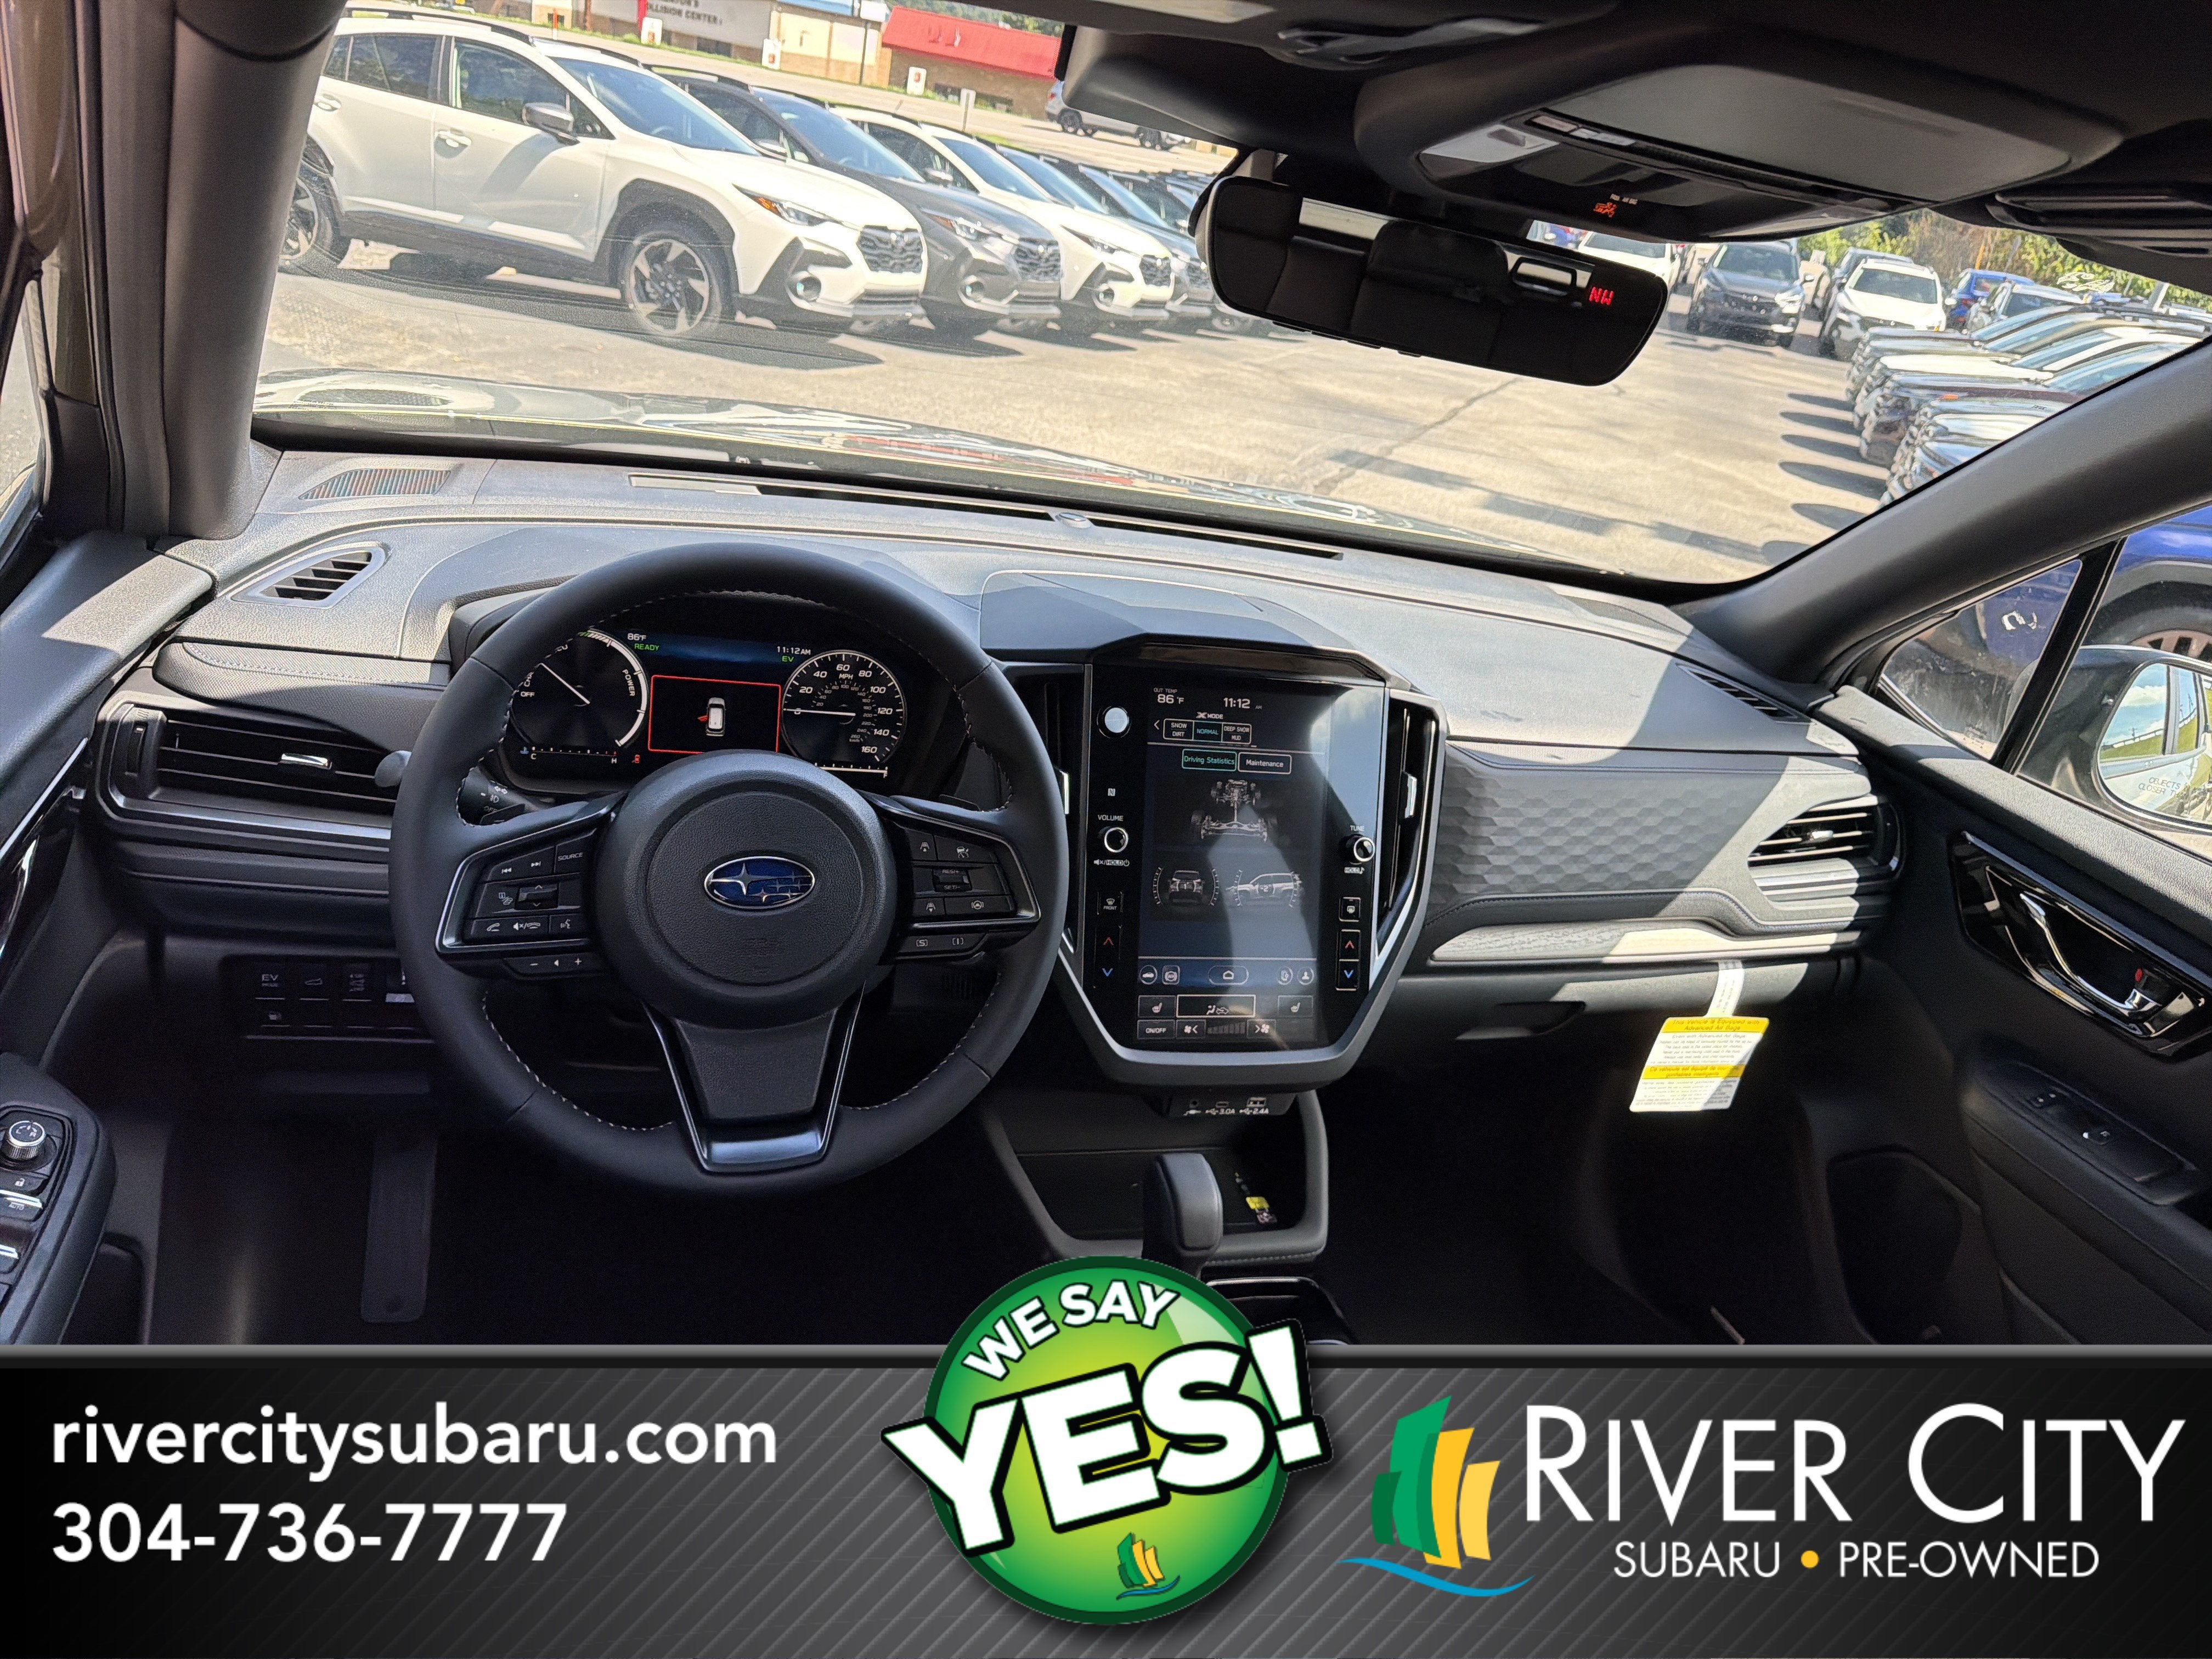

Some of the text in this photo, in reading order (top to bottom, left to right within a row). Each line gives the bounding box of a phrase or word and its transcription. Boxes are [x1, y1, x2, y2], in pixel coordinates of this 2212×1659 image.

[1589, 286, 1615, 306] NW
[622, 669, 635, 697] POWER
[1158, 693, 1174, 704] 86
[1223, 697, 1250, 709] 11:12
[1184, 755, 1235, 765] Driving Statistics
[1246, 759, 1284, 768] Maintenance
[2138, 783, 2166, 794] CLOSER
[2149, 777, 2181, 790] OBJECTS
[558, 852, 583, 861] SOURCE
